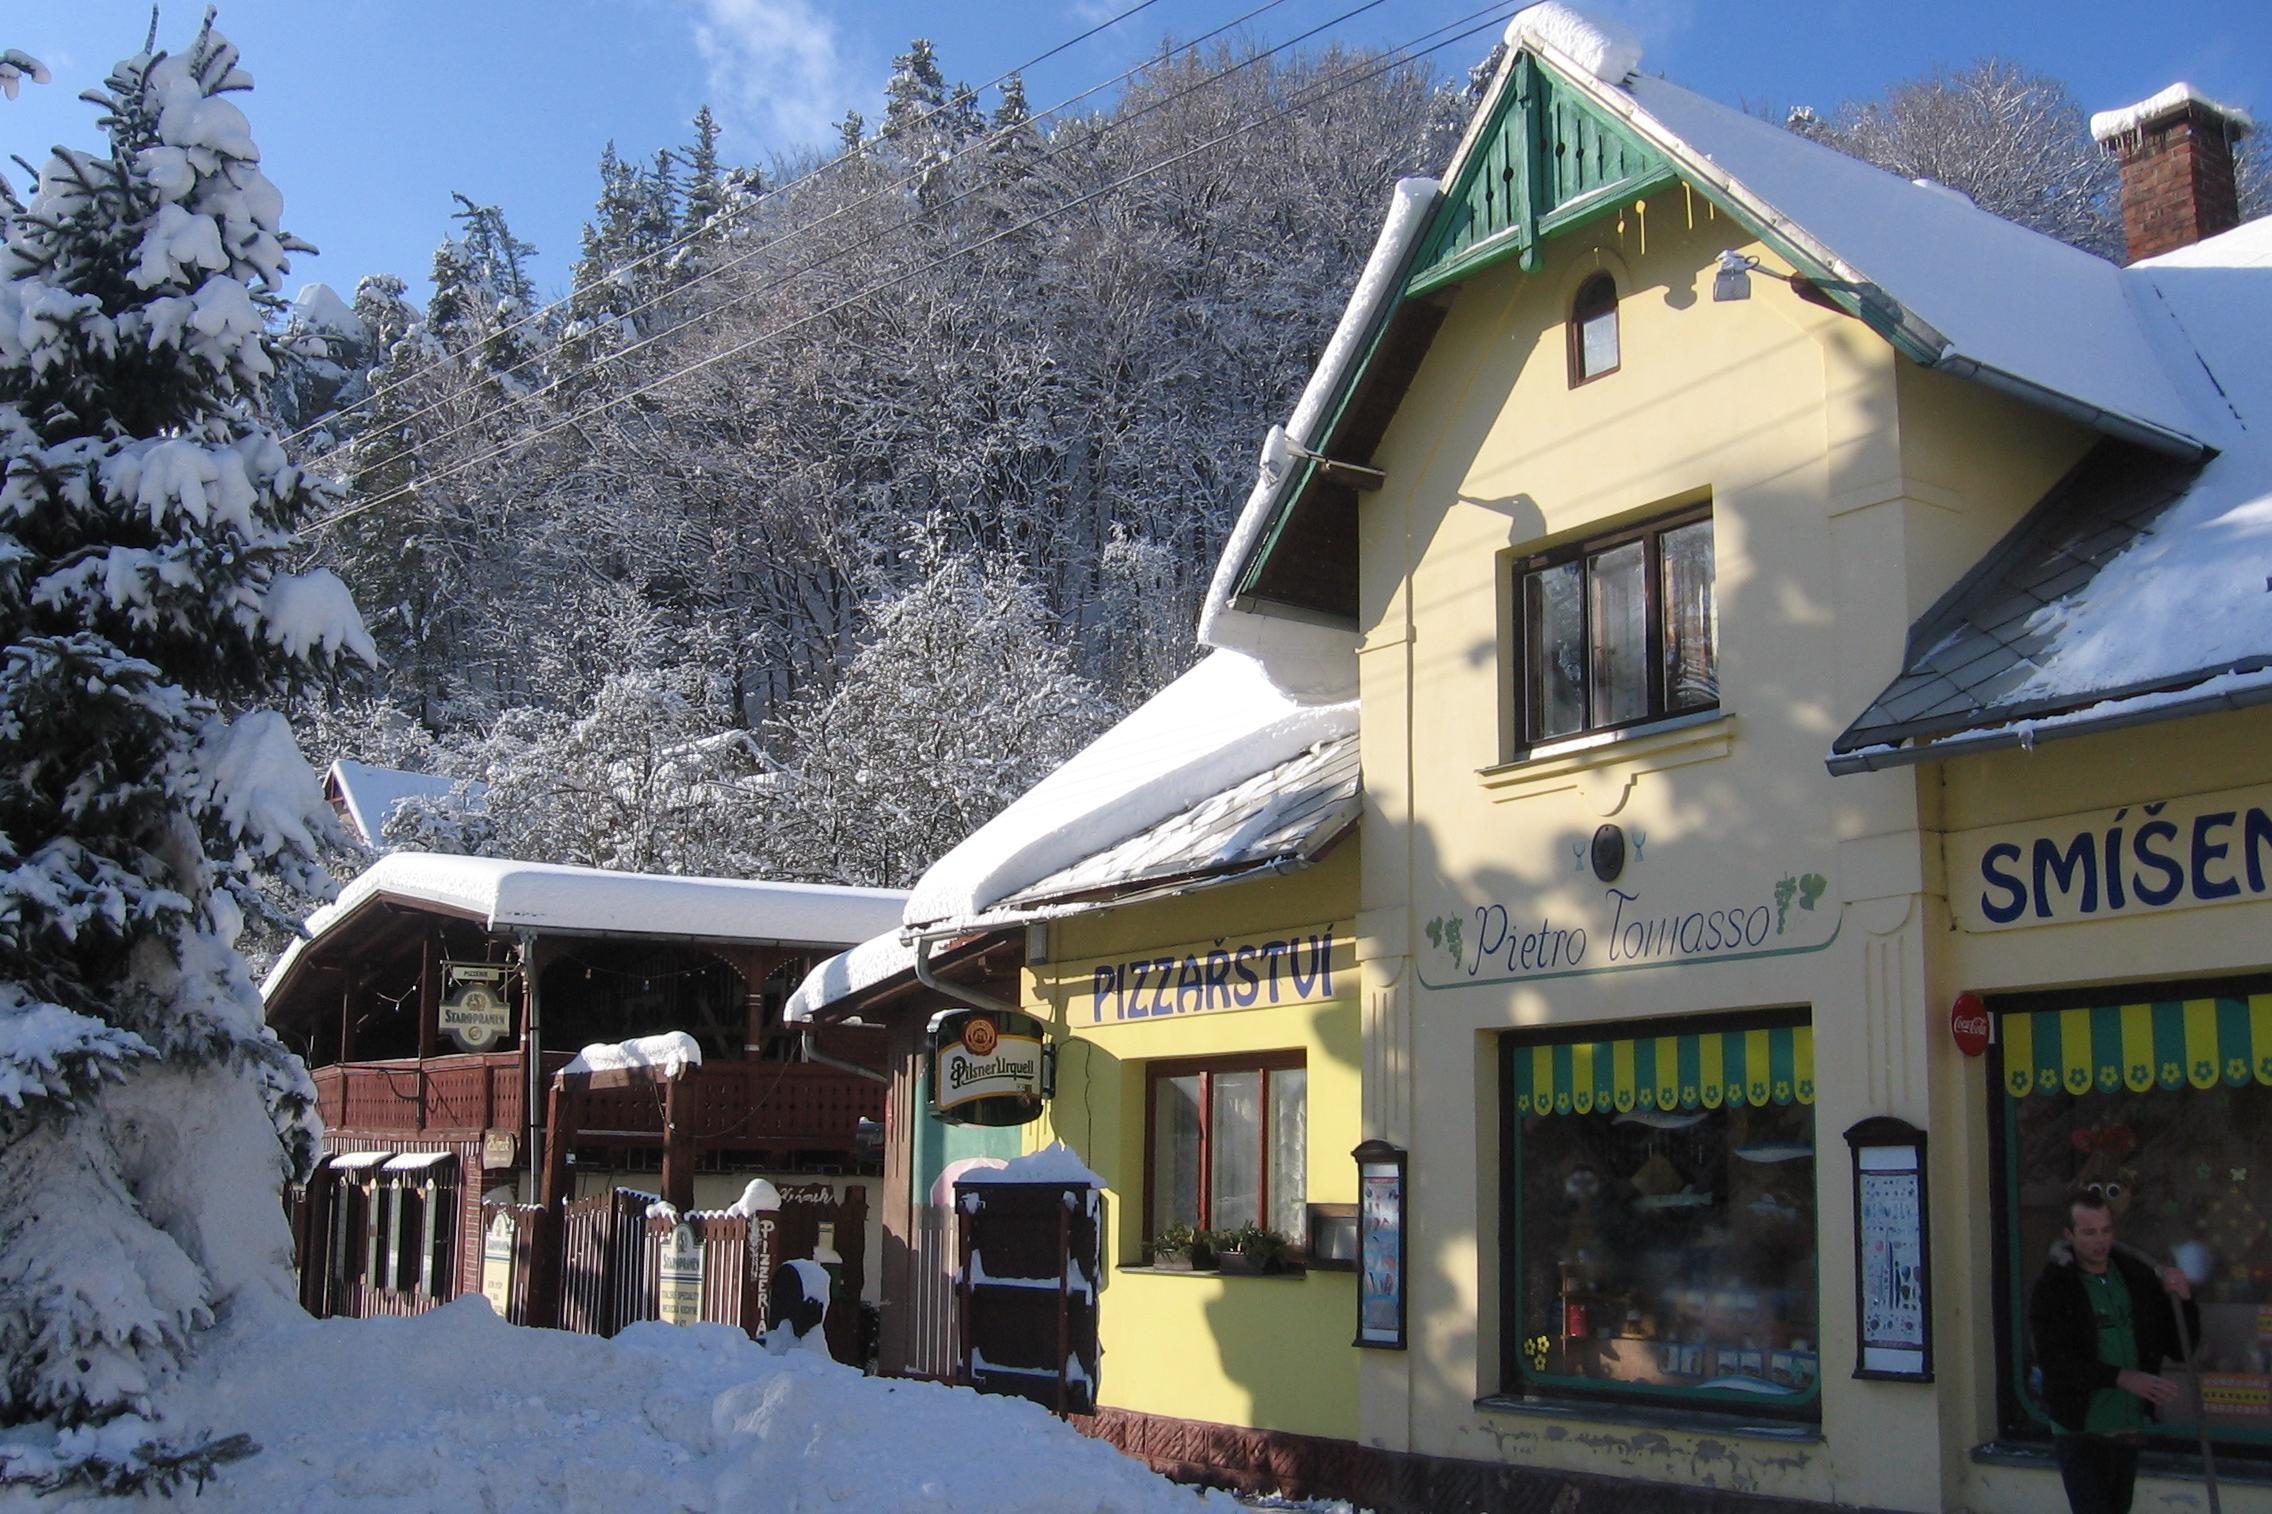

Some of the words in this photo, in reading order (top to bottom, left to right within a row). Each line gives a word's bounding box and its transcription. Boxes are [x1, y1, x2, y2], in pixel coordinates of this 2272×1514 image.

[1093, 923, 1335, 1023] PIZZAŘSTVÍ
[1467, 903, 1588, 977] Pietro
[1605, 887, 1771, 962] Tomasso
[950, 1055, 997, 1090] Pilsner
[996, 1055, 1034, 1081] Urquell
[756, 1219, 776, 1340] PIZZERIA
